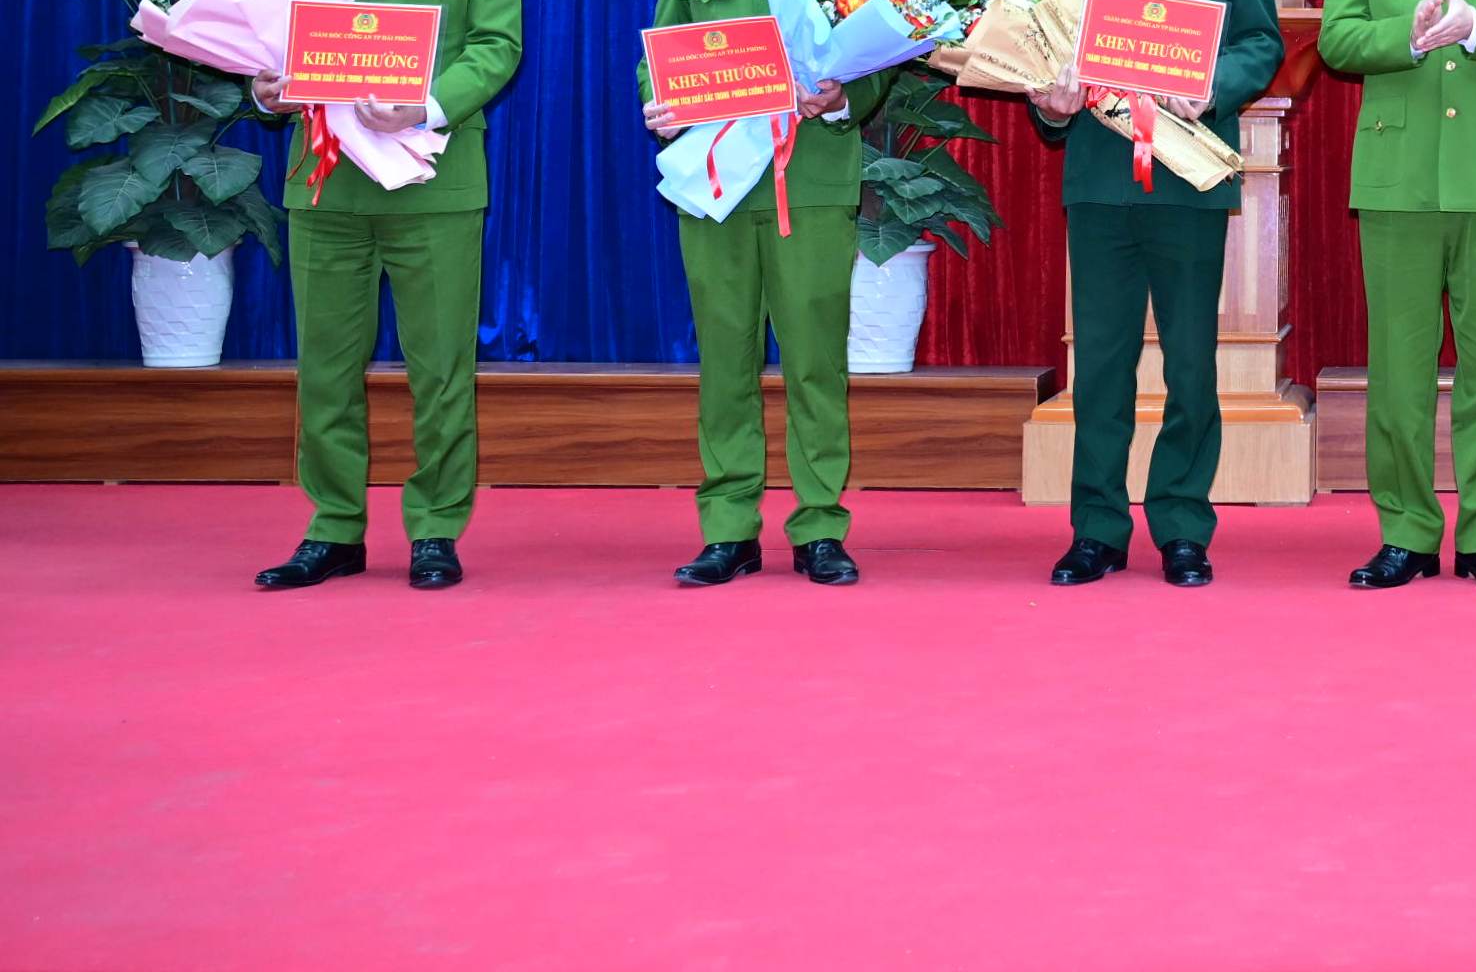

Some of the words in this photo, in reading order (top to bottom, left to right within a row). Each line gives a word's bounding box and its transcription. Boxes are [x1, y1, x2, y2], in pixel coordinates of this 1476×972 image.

[303, 51, 348, 66] KHEN
[352, 50, 419, 69] THƯỞNG
[1094, 34, 1137, 52] KHEN
[1140, 41, 1202, 63] THƯỞNG
[668, 72, 710, 90] KHEN
[713, 62, 777, 84] THƯỞNG
